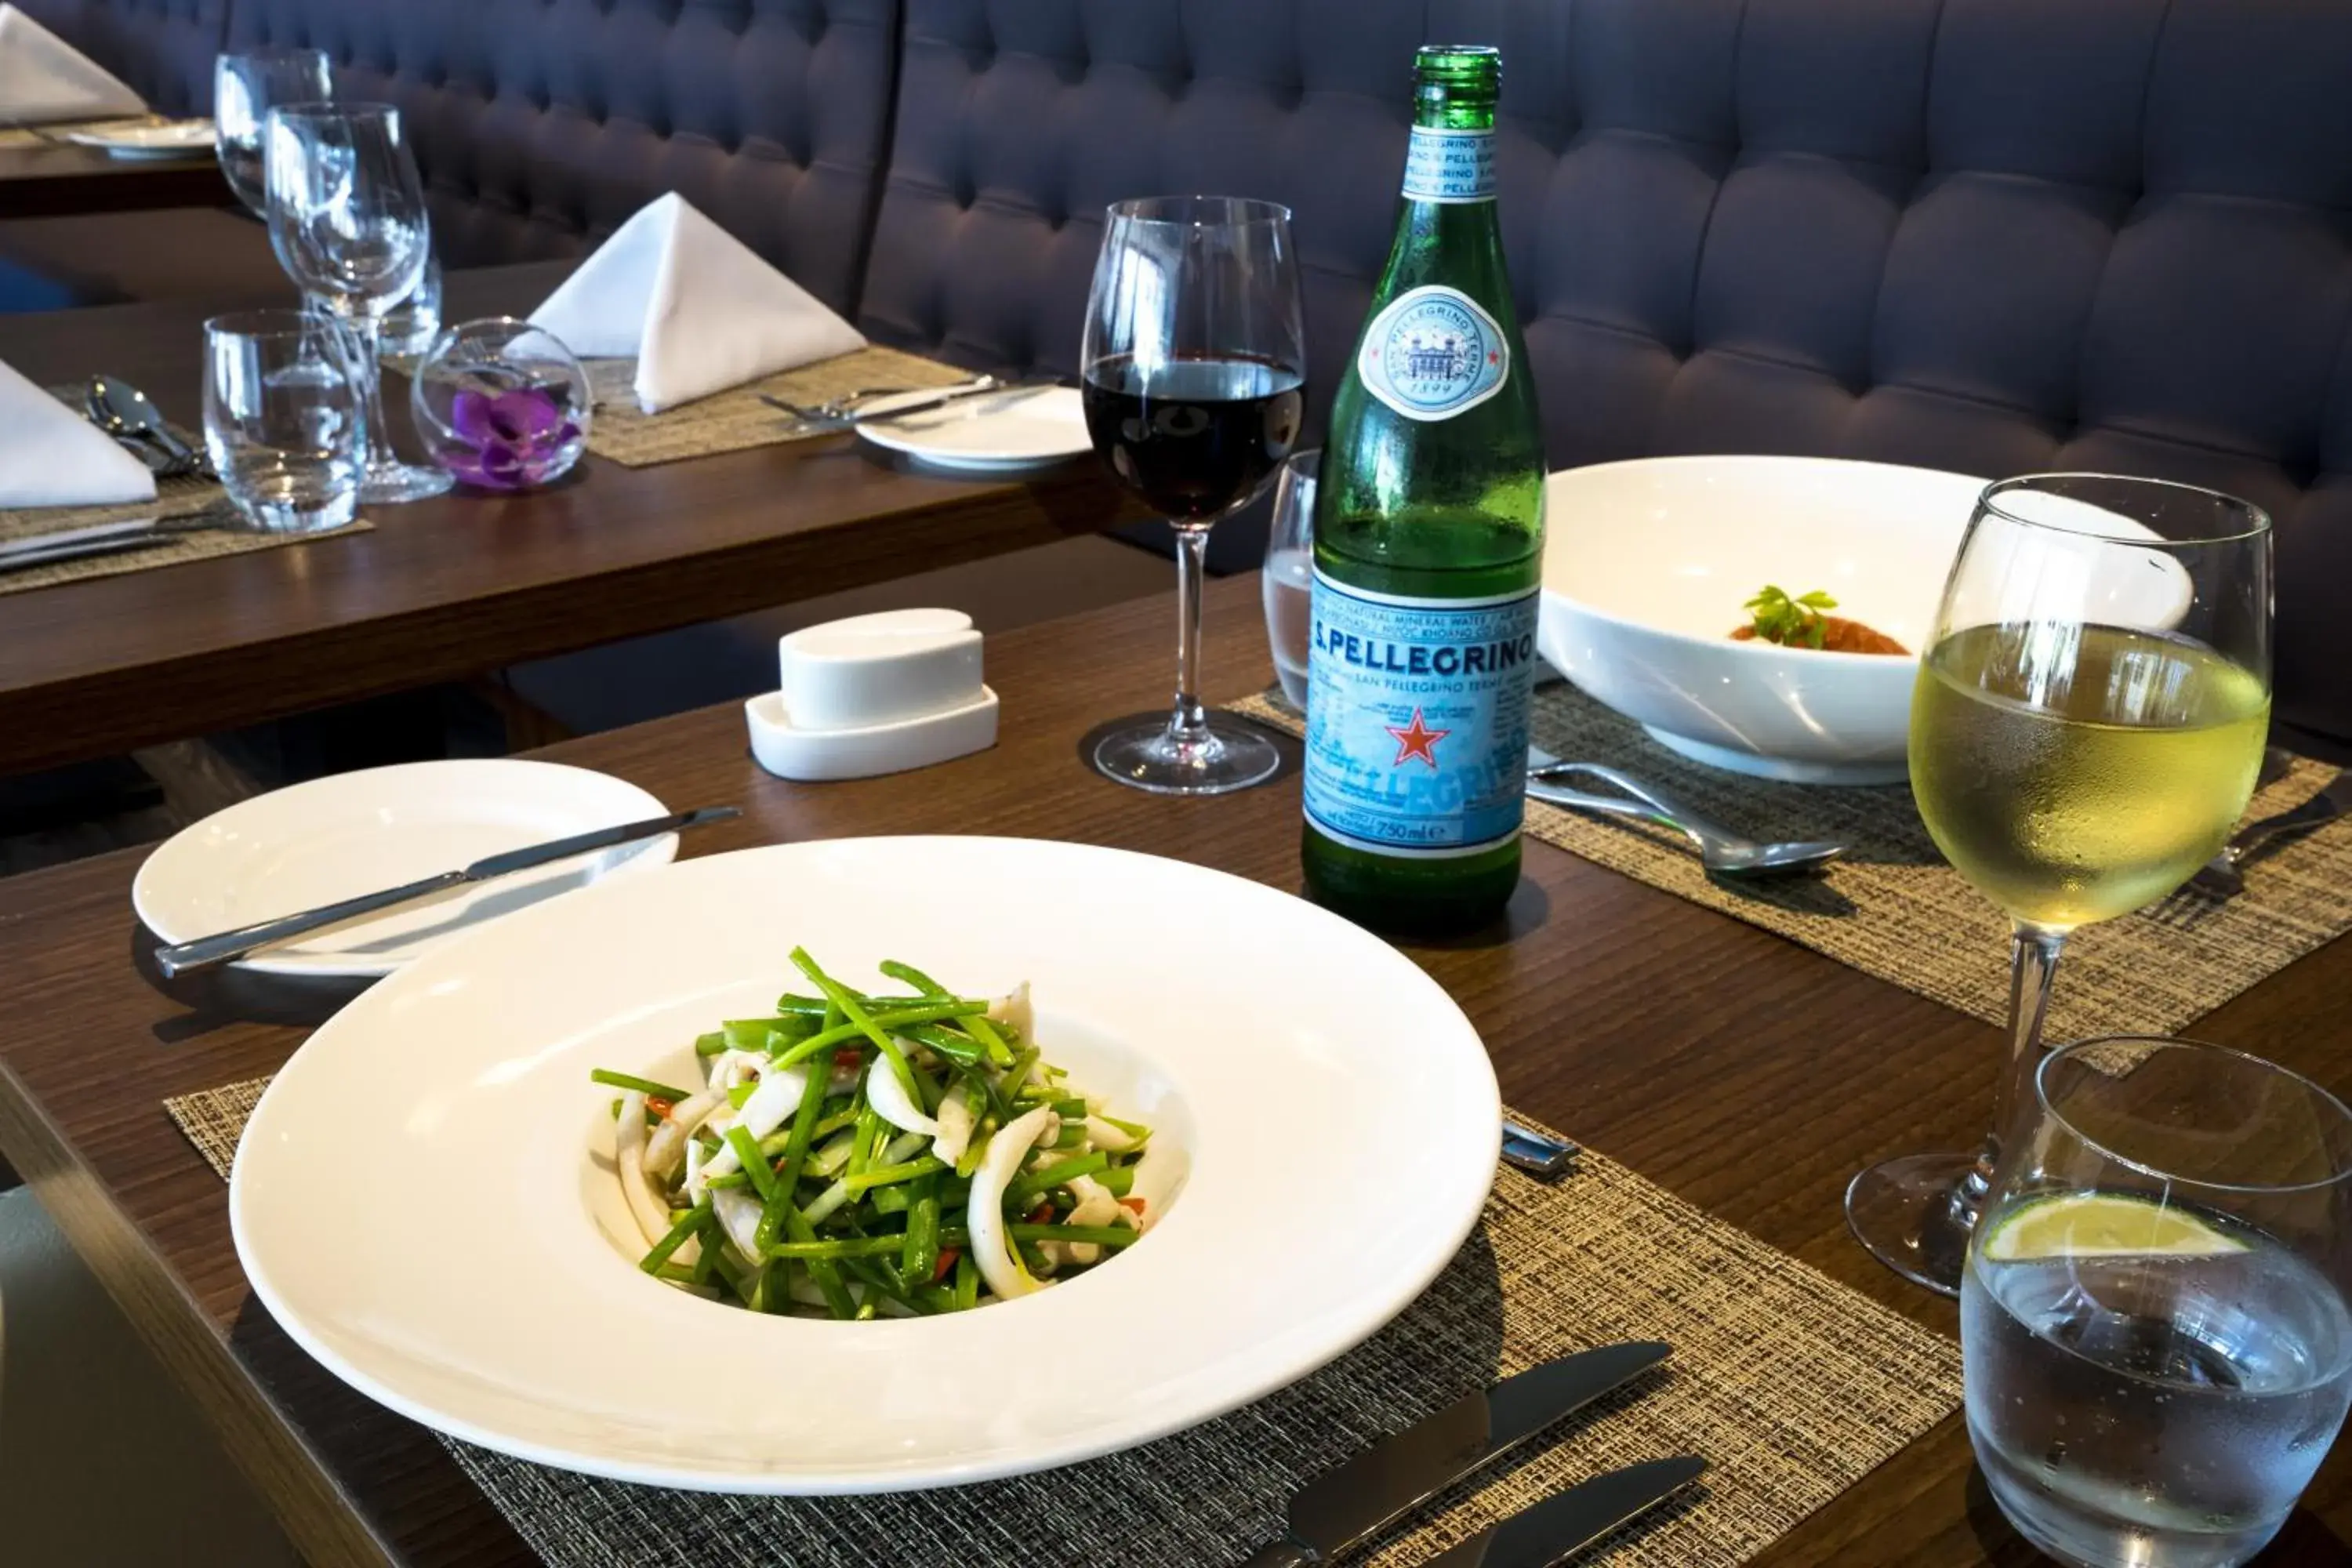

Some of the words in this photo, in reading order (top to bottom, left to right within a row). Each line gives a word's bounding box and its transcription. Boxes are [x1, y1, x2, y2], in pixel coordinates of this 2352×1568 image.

[1395, 613, 1448, 627] MINERAL
[1452, 615, 1486, 626] WATER
[1356, 673, 1381, 686] SAN
[1385, 677, 1464, 694] PELLEGRINO
